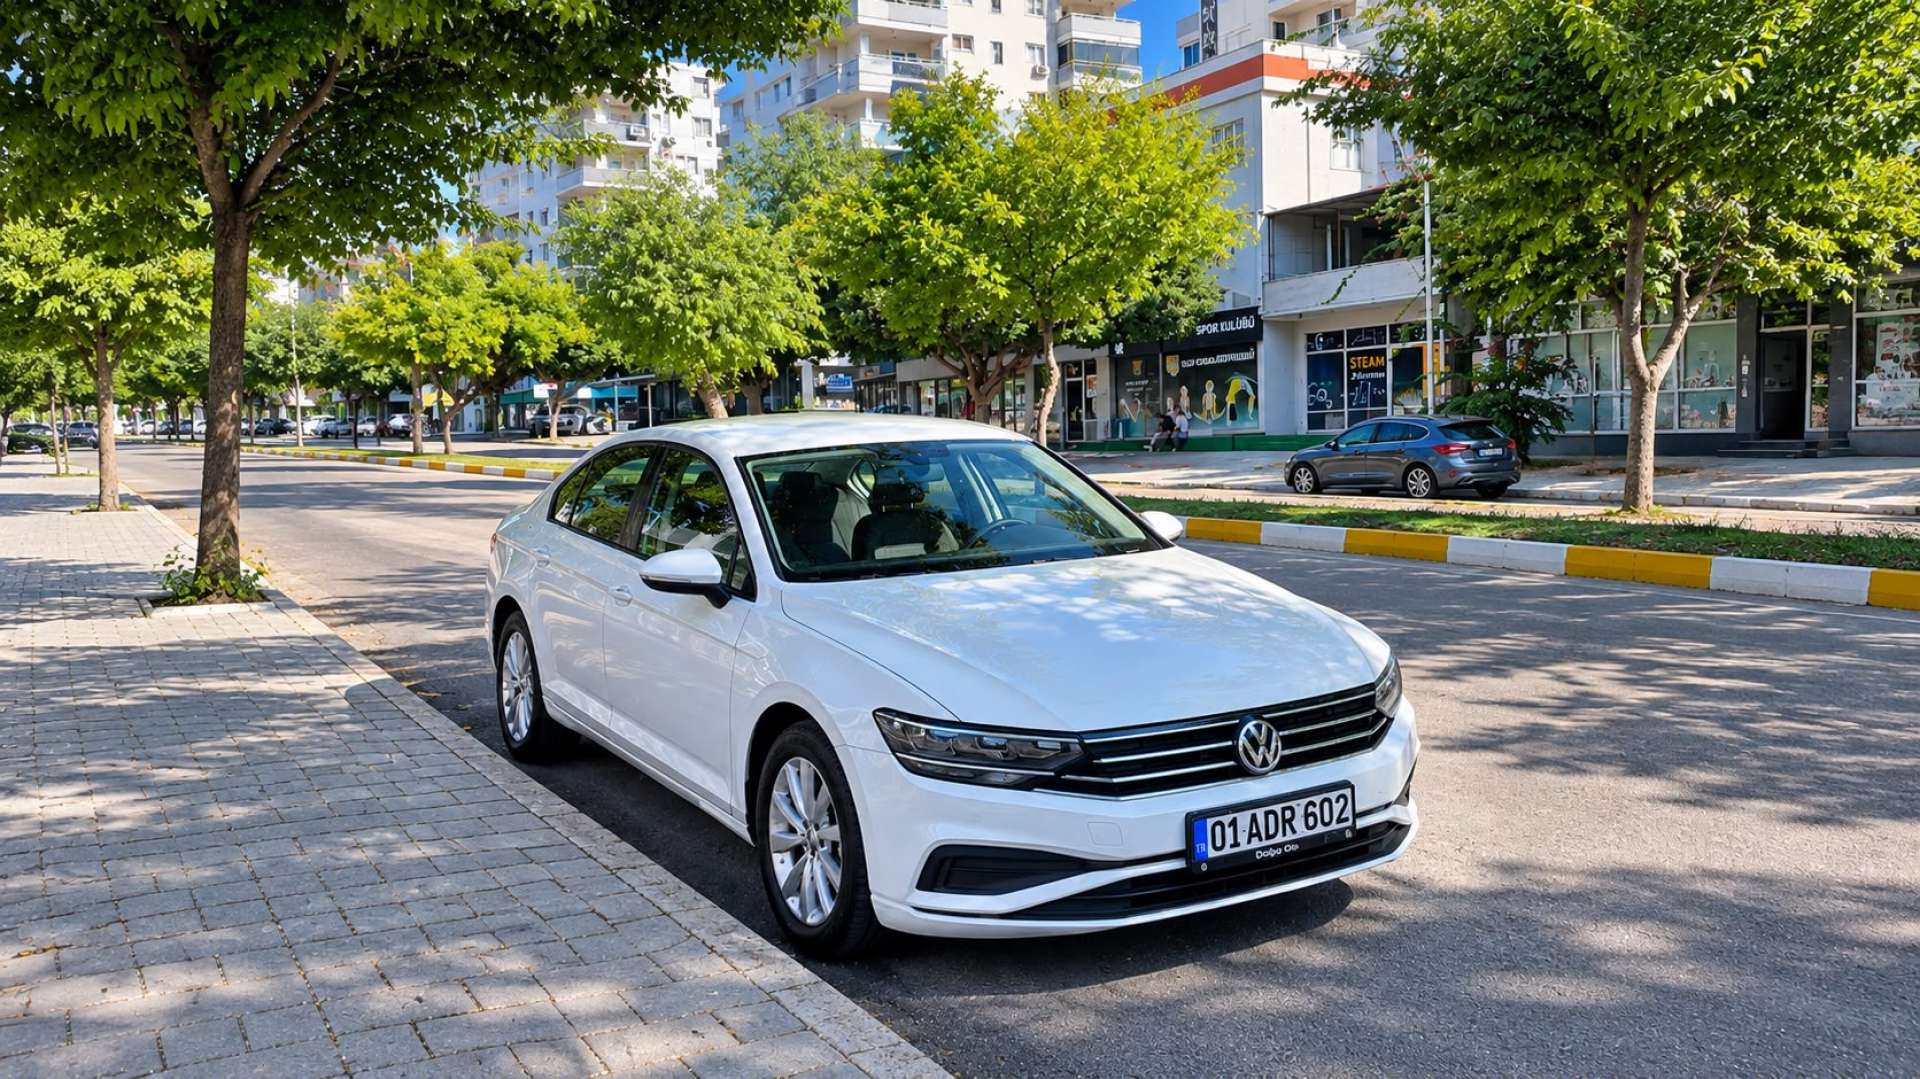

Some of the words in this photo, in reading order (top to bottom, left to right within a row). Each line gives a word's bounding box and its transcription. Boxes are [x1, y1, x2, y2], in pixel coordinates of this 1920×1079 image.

[1196, 322, 1219, 335] SPOR
[1350, 355, 1385, 370] STEAM
[1210, 816, 1241, 852] 01
[1246, 805, 1297, 845] ADR
[1303, 793, 1350, 831] 602
[1195, 843, 1206, 853] TR
